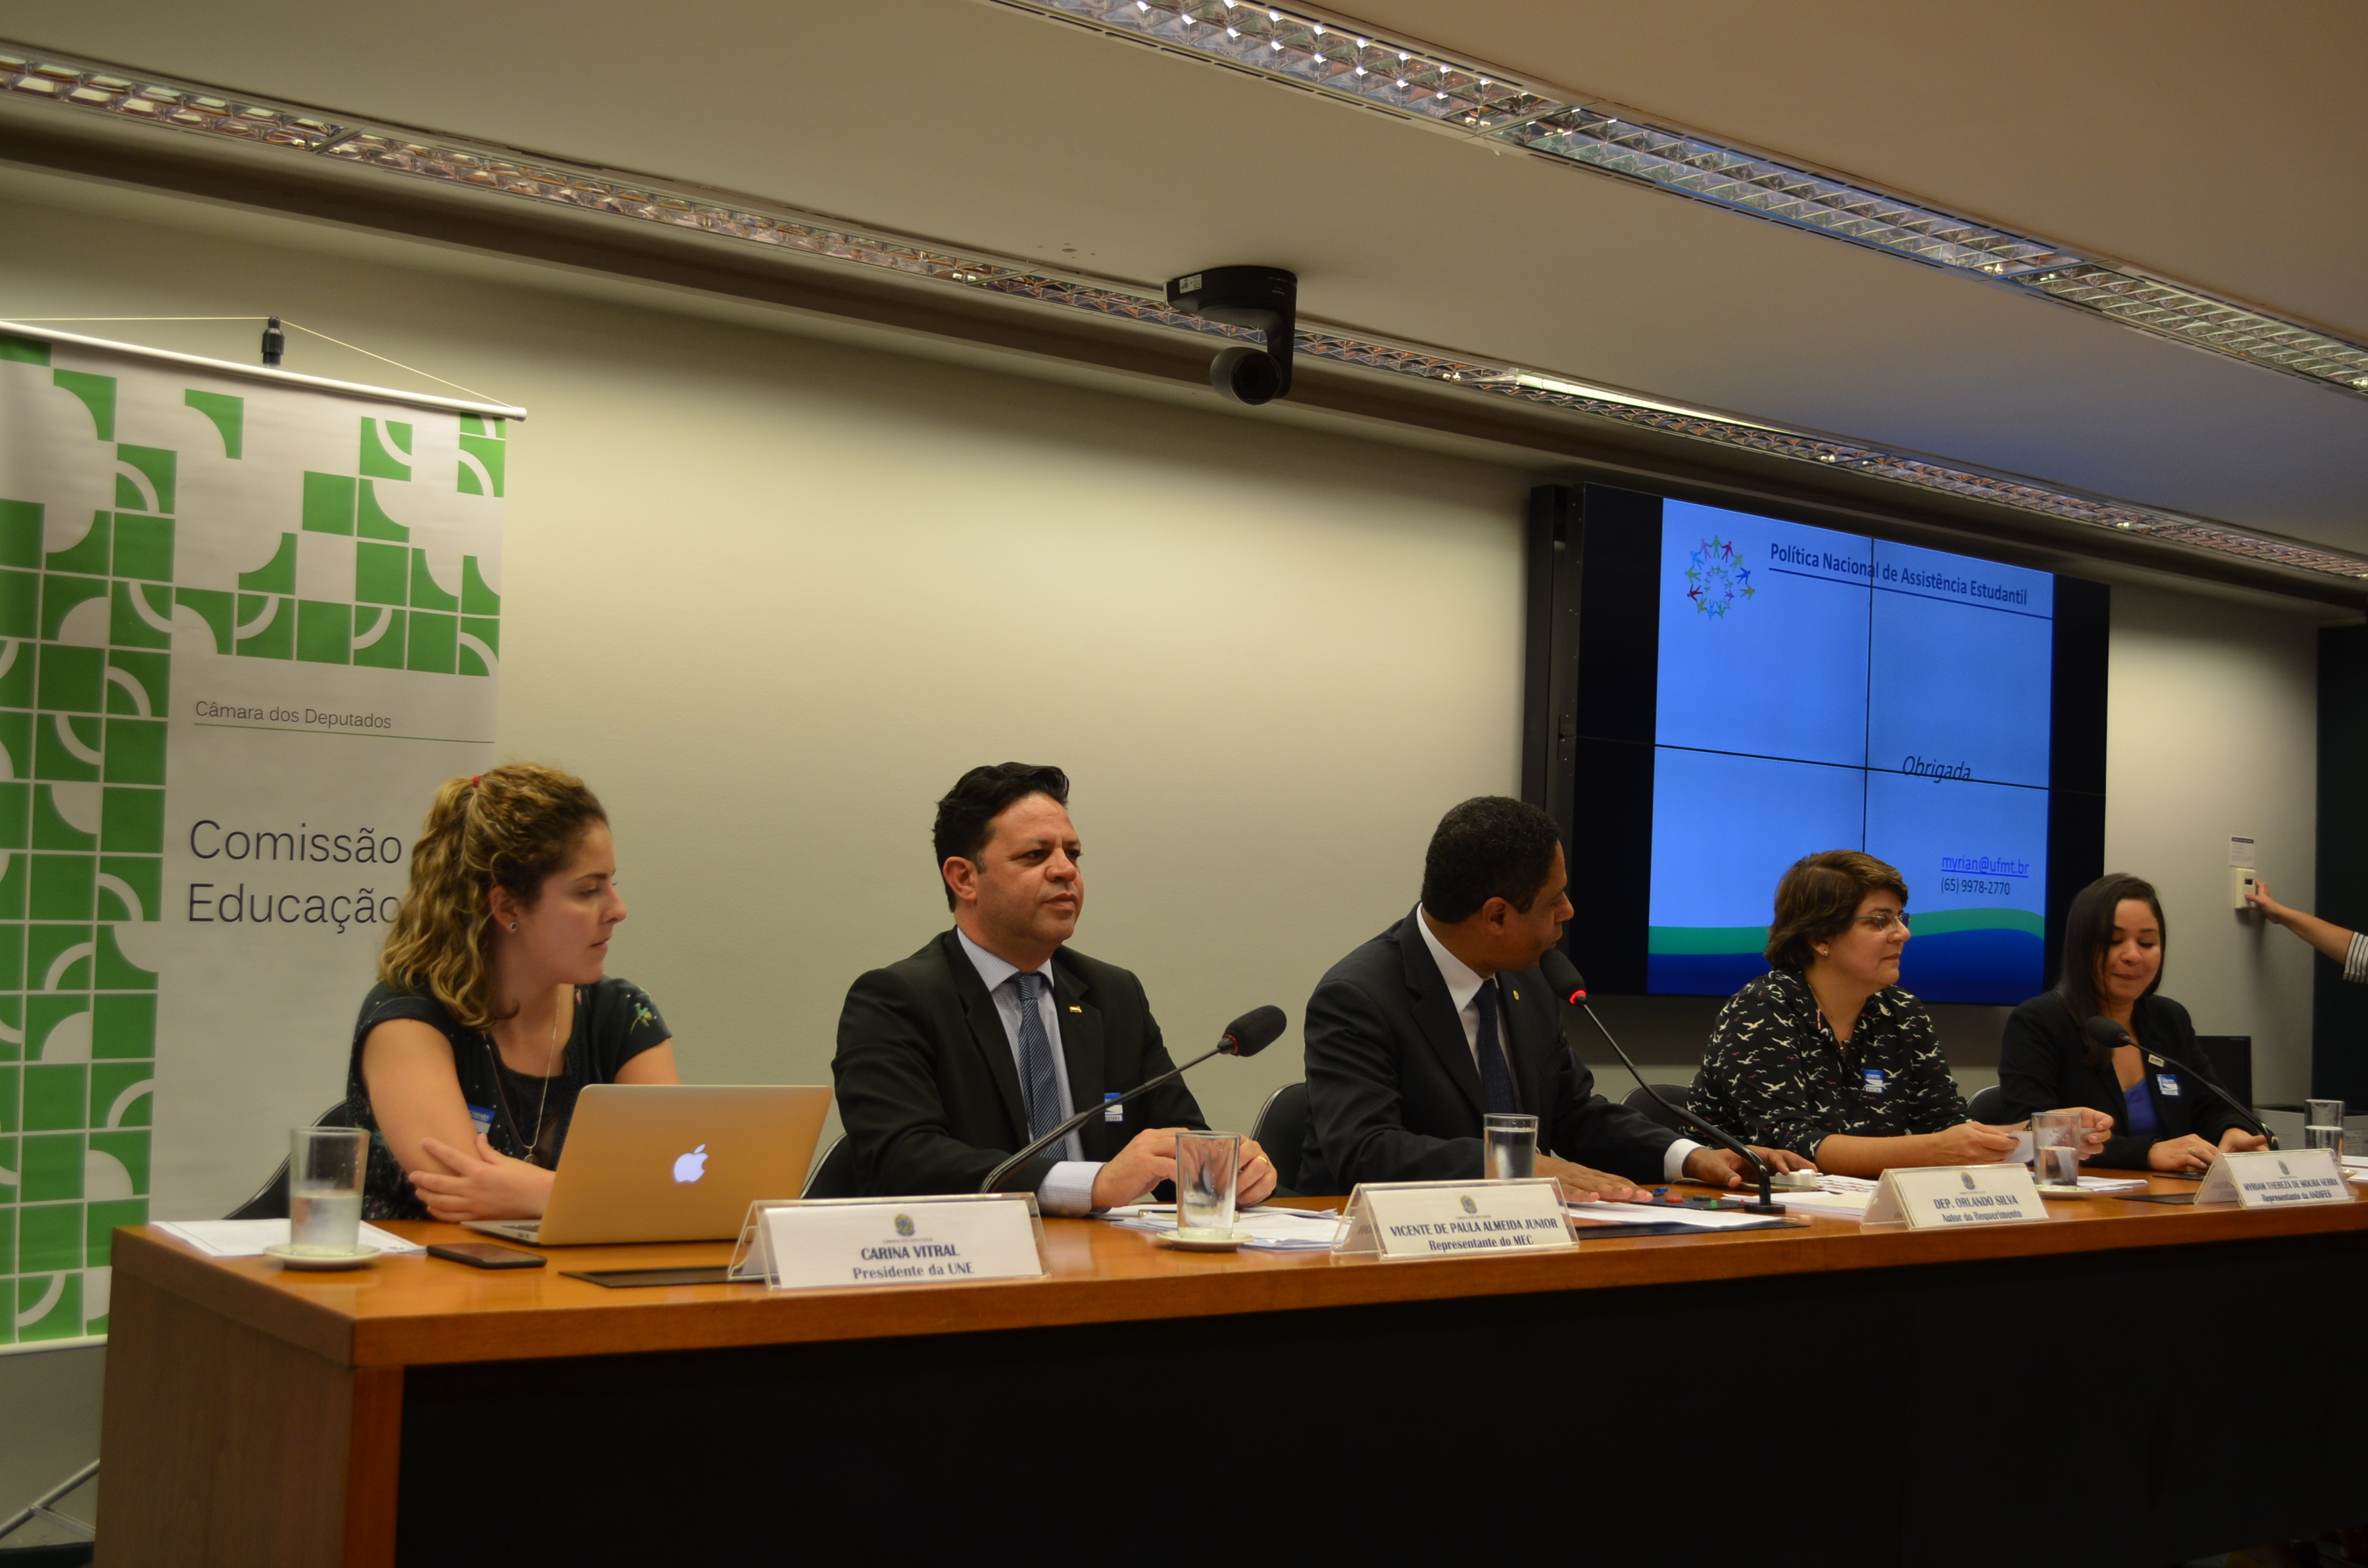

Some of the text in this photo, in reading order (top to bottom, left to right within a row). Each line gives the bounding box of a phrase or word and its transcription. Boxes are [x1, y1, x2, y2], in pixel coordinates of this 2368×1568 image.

[1771, 543, 2027, 606] Política Nacional de Assistência Estudantil
[195, 701, 391, 729] Câmara dos Deputados
[190, 820, 402, 864] Comissão
[1942, 855, 2030, 875] myrian@ufmt.br
[1941, 878, 2010, 895] (65) 9978-2770
[189, 883, 400, 934] Educação
[1934, 1195, 2019, 1209] DEP. ORLANDO SILVA
[2261, 1191, 2301, 1204] Representante
[2302, 1191, 2308, 1200] da
[1942, 1210, 2022, 1222] Autor do Requerimento
[1390, 1223, 1433, 1237] VICENTE
[1435, 1223, 1449, 1234] DE
[1451, 1221, 1481, 1233] PAULA
[1483, 1220, 1524, 1232] ALMEIDA
[1525, 1218, 1558, 1230] JUNIOR
[1429, 1235, 1534, 1252] Representante do MEC
[861, 1244, 960, 1261] CARINA VITRAL
[853, 1262, 974, 1279] Presidente da UNE
